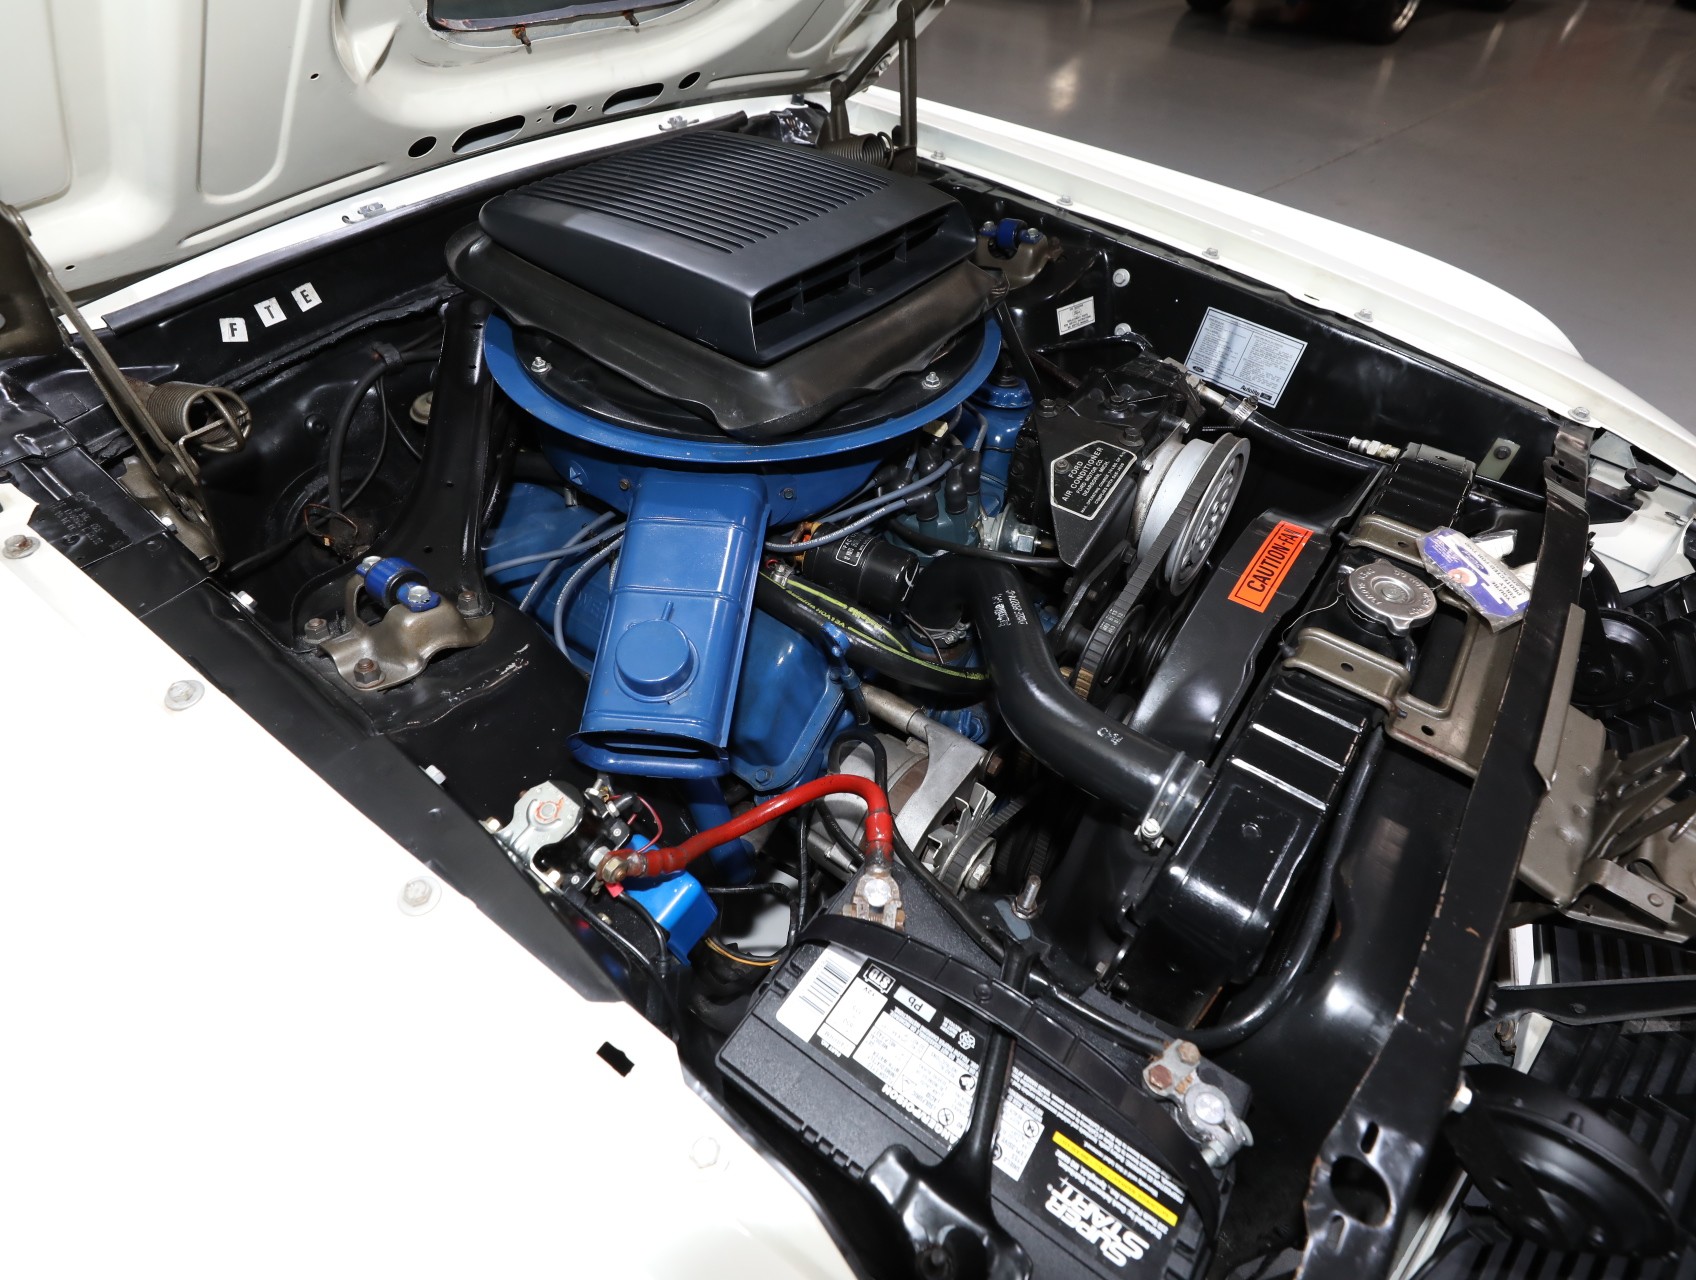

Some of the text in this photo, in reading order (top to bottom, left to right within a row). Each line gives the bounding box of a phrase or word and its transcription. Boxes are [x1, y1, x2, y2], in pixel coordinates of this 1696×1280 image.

[229, 289, 312, 337] F T E
[1062, 447, 1103, 502] AIR CONDITIONER
[1068, 461, 1083, 478] FORD
[1076, 482, 1087, 494] FORD
[1085, 467, 1097, 482] MOTOR
[909, 996, 924, 1012] Pb
[882, 1085, 959, 1147] ANGER/POISON
[1045, 1196, 1127, 1267] SUPER
[1051, 1186, 1150, 1260] START
